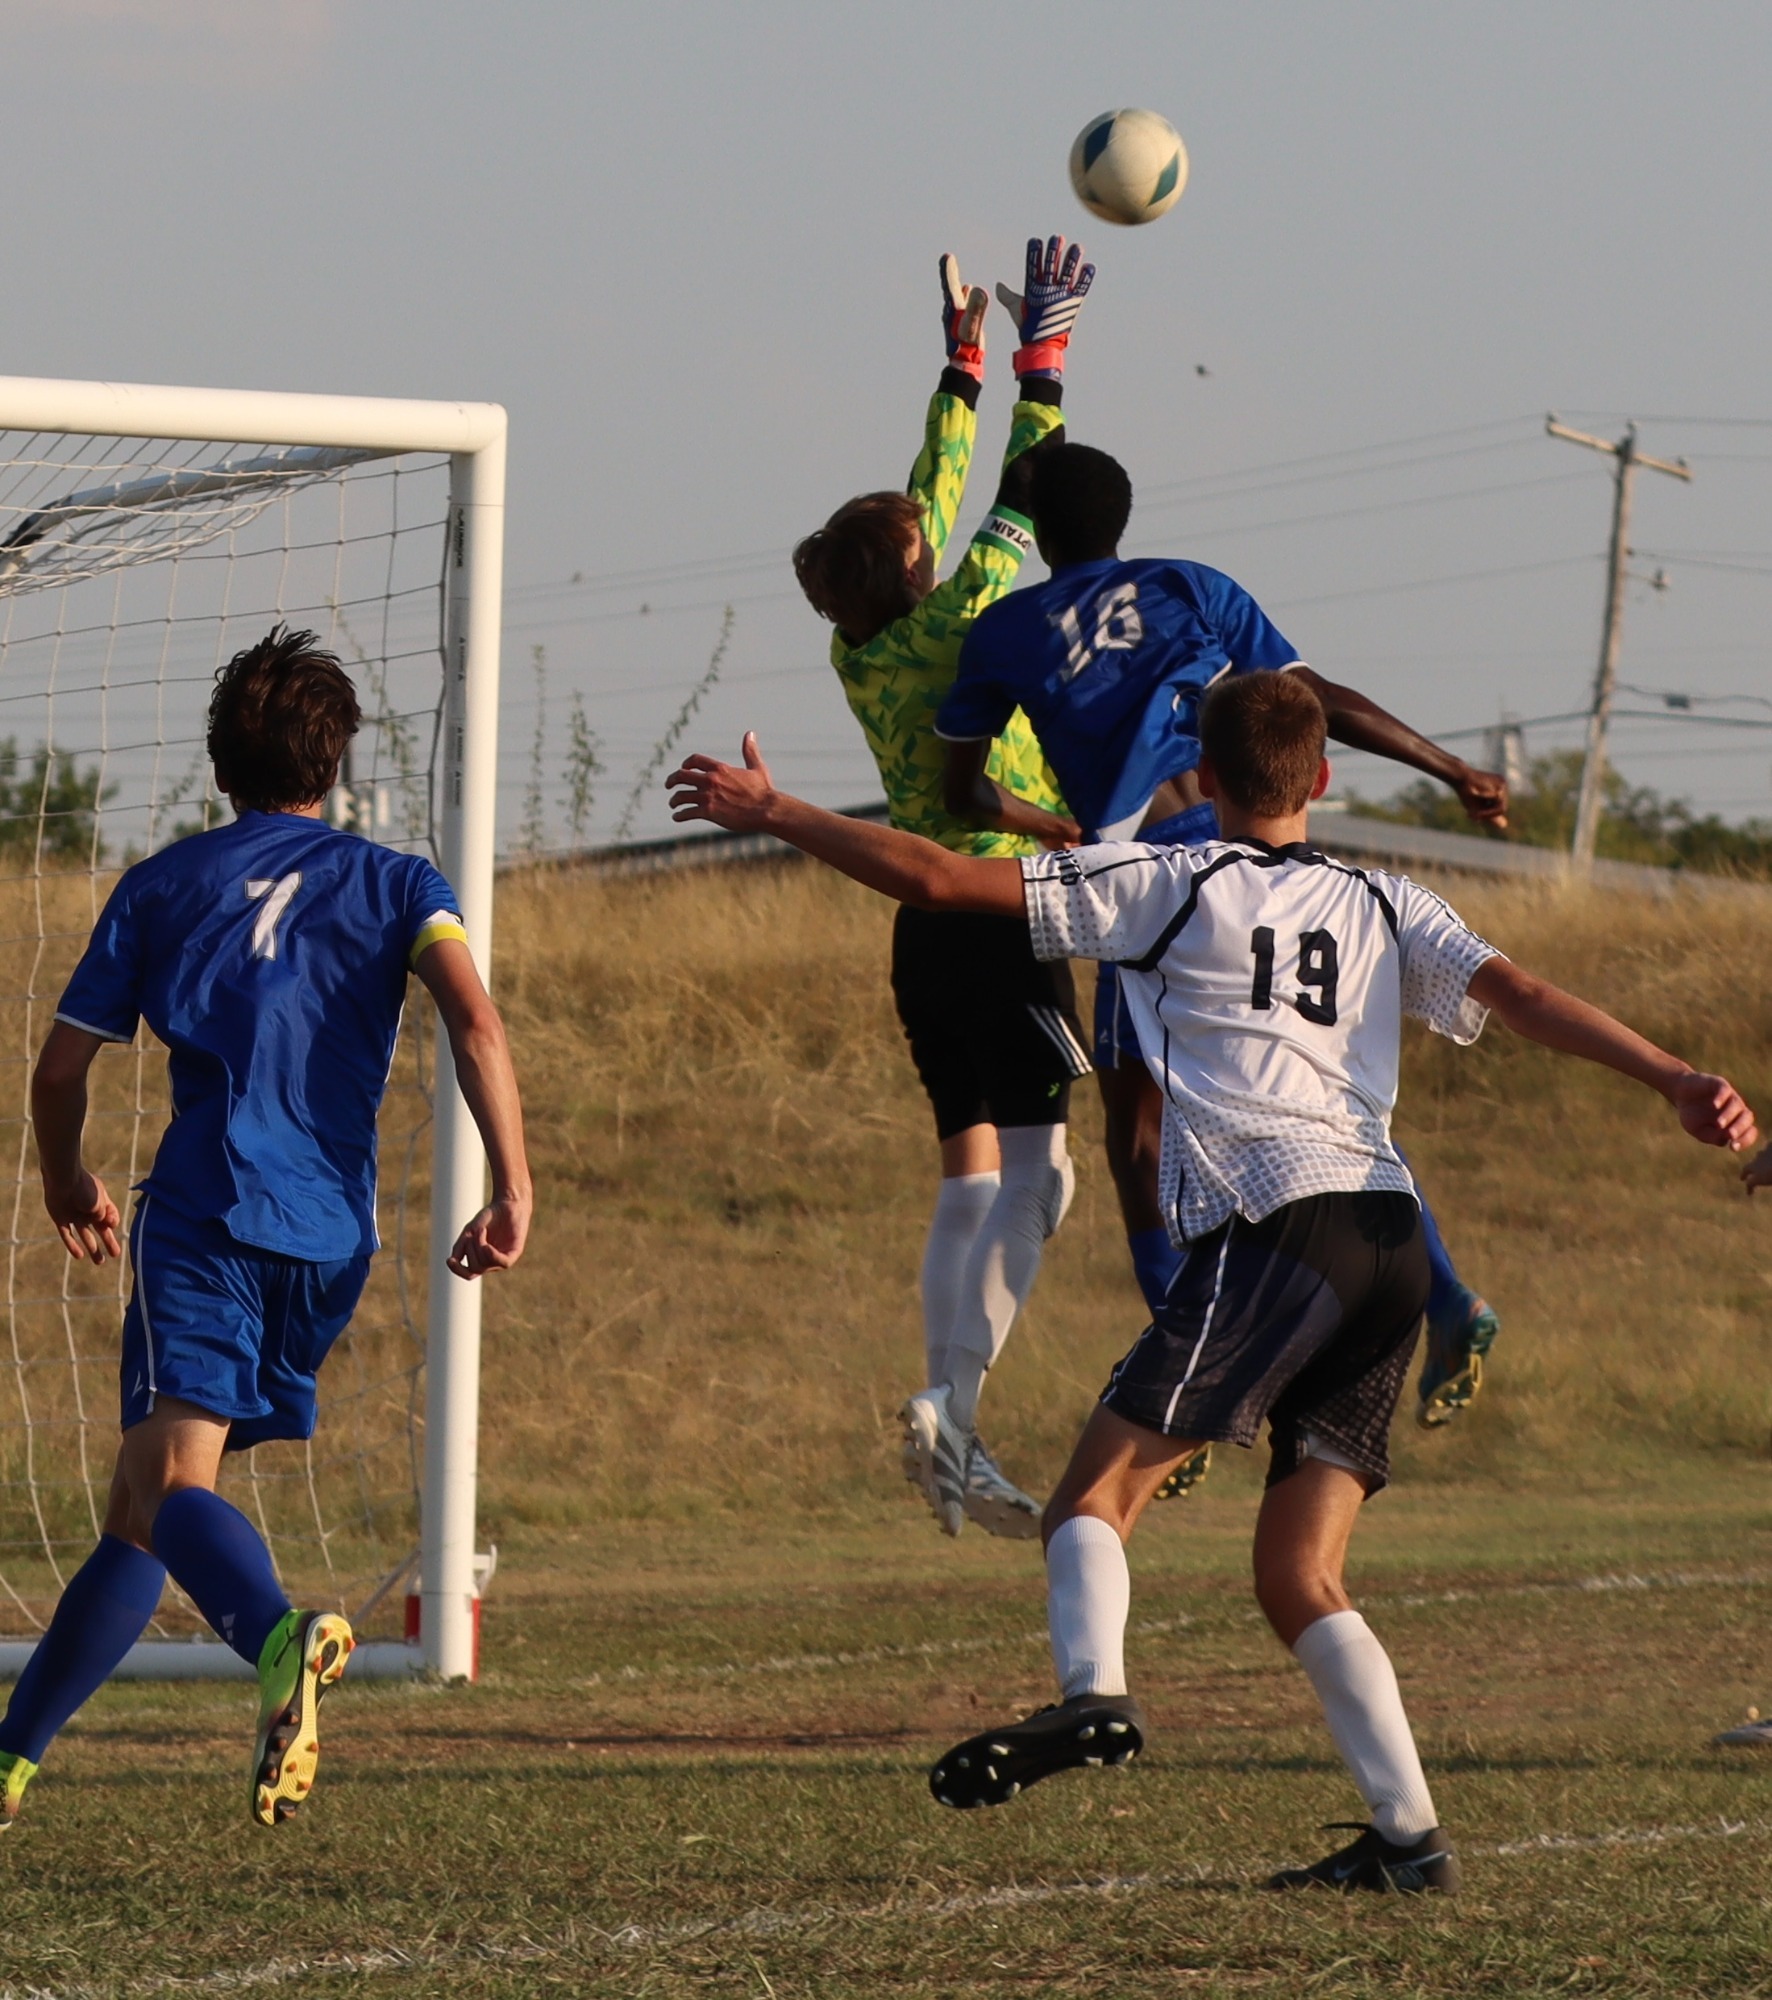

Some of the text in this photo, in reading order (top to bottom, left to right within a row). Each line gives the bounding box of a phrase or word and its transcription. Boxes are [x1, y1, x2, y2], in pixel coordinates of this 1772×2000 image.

[989, 519, 1031, 550] PTAIN
[245, 870, 302, 961] 7
[1250, 925, 1339, 1027] 19
